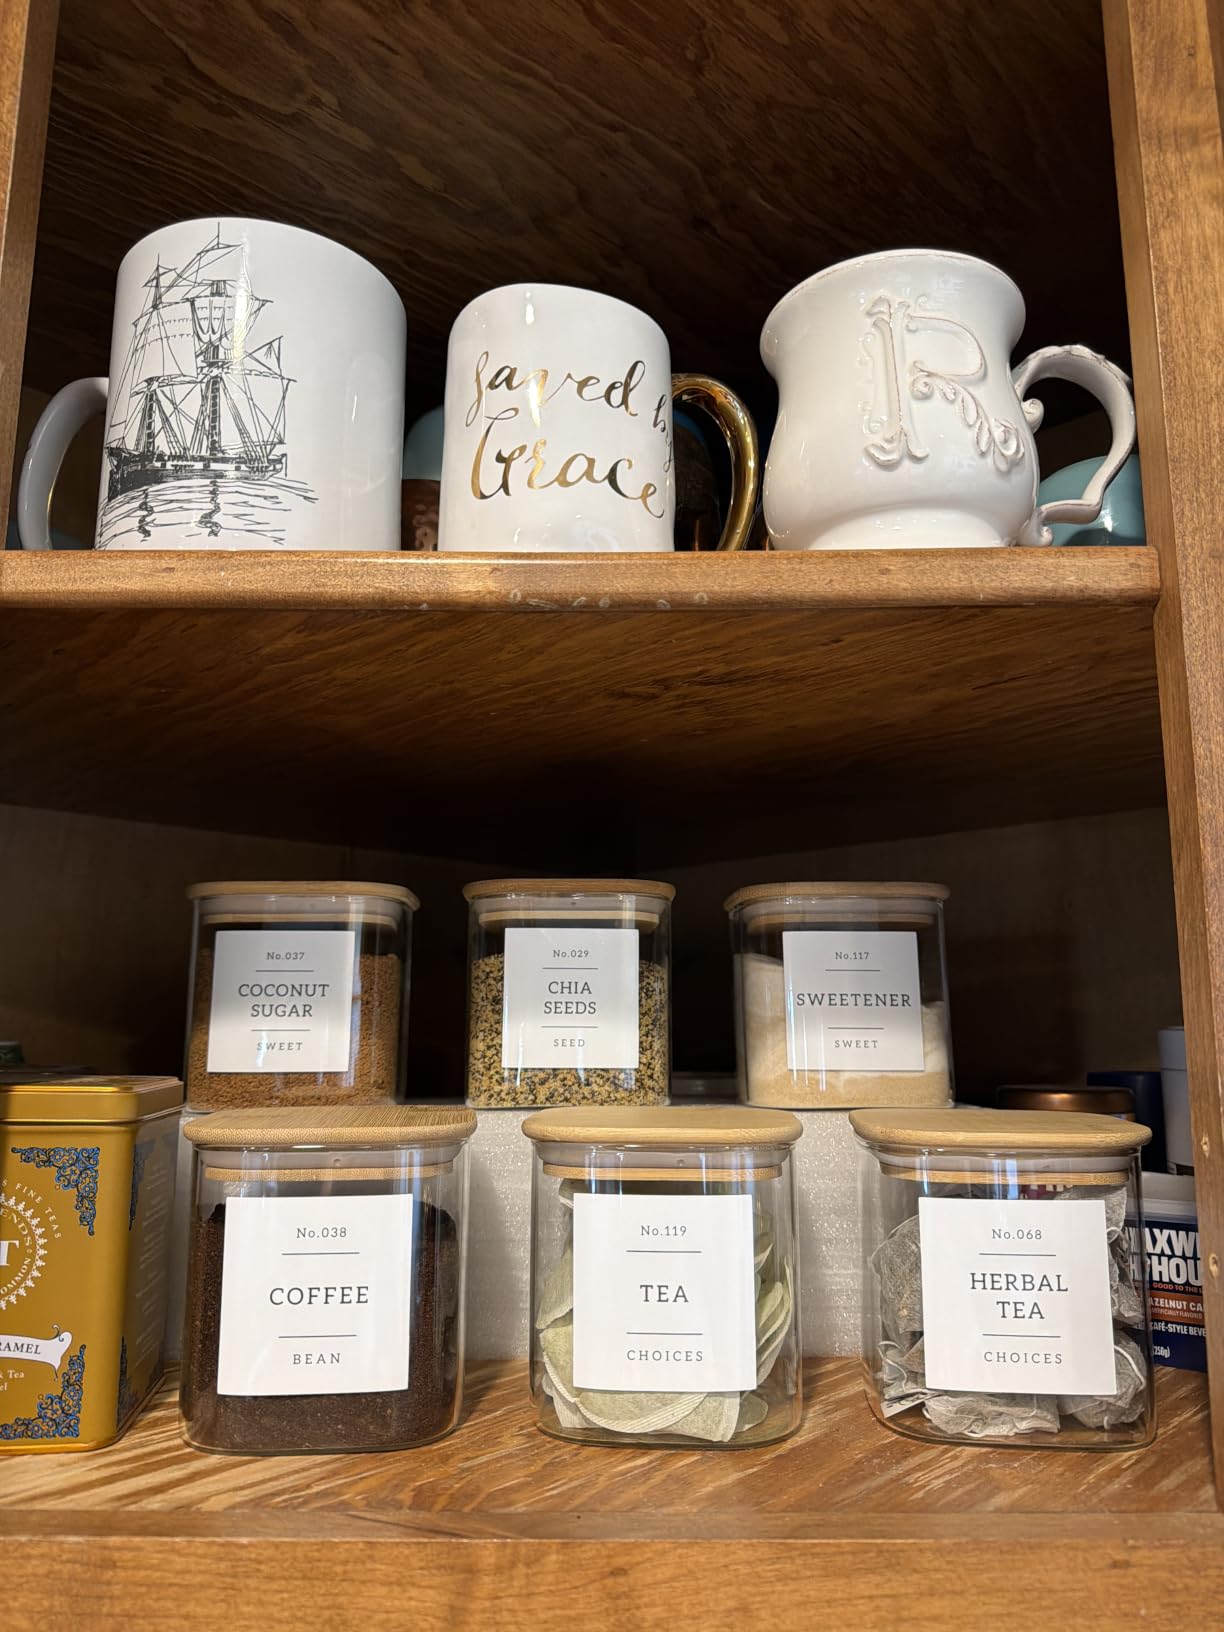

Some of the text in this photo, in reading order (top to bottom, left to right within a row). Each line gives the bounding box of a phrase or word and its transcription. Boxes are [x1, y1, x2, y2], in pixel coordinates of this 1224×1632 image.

[470, 407, 665, 518] Grace
[266, 951, 305, 961] No.037
[552, 949, 590, 959] No.029
[834, 951, 870, 961] No.117
[237, 983, 331, 999] COCONUT
[547, 980, 593, 995] CHIA
[796, 992, 912, 1008] SWEETENER
[250, 1001, 313, 1018] SUGAR
[543, 1000, 597, 1016] SEEDS
[256, 1041, 304, 1052] SWEET
[553, 1038, 586, 1048] SEED
[834, 1039, 879, 1049] SWEET
[16, 1183, 62, 1239] FINE TEAS
[0, 1208, 32, 1246] ENDS
[295, 1226, 347, 1239] No.038
[639, 1224, 687, 1237] No.119
[991, 1228, 1043, 1241] No.068
[1143, 1227, 1200, 1258] AXW
[1151, 1254, 1203, 1286] HOU
[969, 1271, 1069, 1293] HERBAL
[1152, 1282, 1174, 1291] GOOD
[1174, 1284, 1184, 1292] TO
[1184, 1286, 1198, 1294] THE
[269, 1285, 369, 1306] COFFEE
[639, 1284, 690, 1304] TEA
[995, 1300, 1046, 1320] TEA
[1149, 1297, 1187, 1310] AZELNUT
[1188, 1327, 1207, 1337] BEVE
[292, 1352, 341, 1366] BEAN
[626, 1349, 704, 1363] CHOICES
[983, 1351, 1064, 1365] CHOICES
[8, 1369, 25, 1379] Tea
